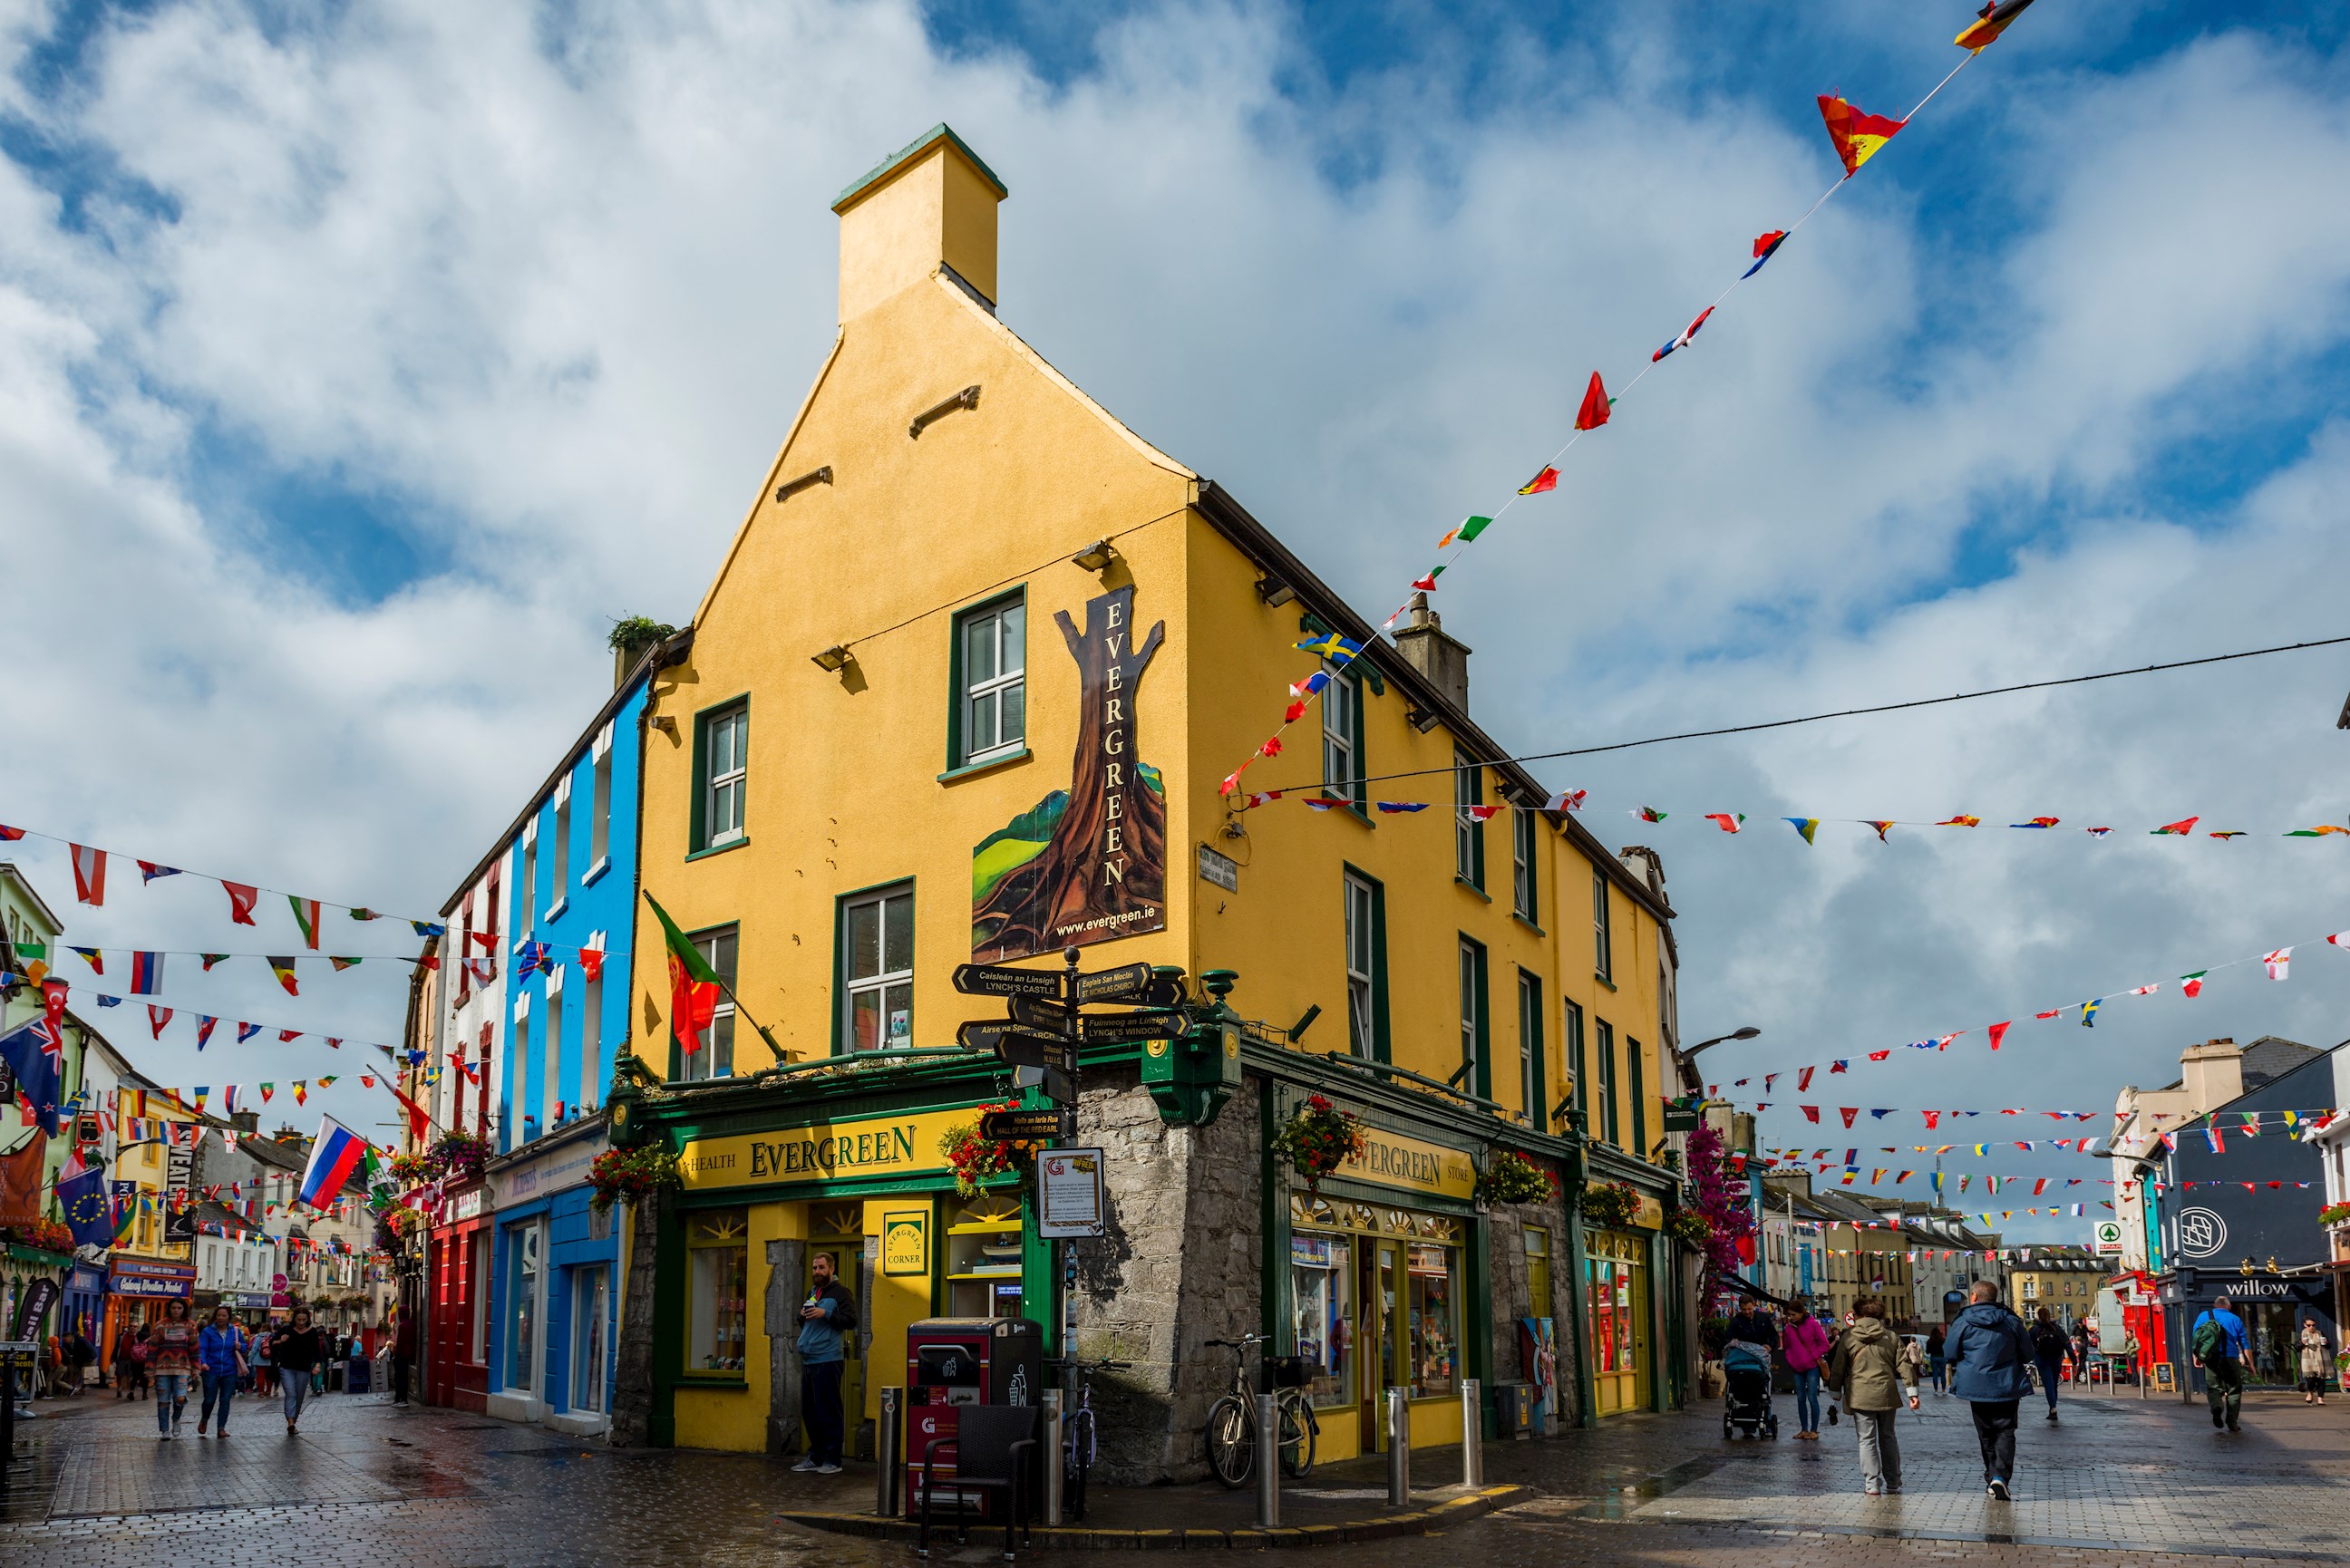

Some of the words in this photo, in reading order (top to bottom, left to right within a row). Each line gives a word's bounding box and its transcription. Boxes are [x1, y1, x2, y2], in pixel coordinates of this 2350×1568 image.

[1104, 602, 1124, 886] EVERGREEN
[1056, 905, 1155, 936] www.evergreen.ie
[1026, 973, 1055, 985] Linsigh
[1102, 975, 1113, 984] San
[986, 982, 1021, 992] LYNCH'S
[1023, 984, 1055, 995] CASTLE
[1089, 985, 1114, 997] NICHOLAS
[1113, 981, 1135, 992] CHURCH
[1089, 1018, 1126, 1027] Fuinneog
[1139, 1016, 1169, 1025] Linsigh
[1089, 1028, 1123, 1037] LYNCH'S
[1125, 1026, 1162, 1035] WINDOW
[1047, 1115, 1059, 1123] Rua
[996, 1127, 1011, 1135] HALL
[1012, 1126, 1020, 1134] OF
[1020, 1126, 1030, 1134] THE
[1031, 1126, 1043, 1134] RED
[1043, 1125, 1059, 1133] EARL
[691, 1154, 736, 1172] HEALTH
[750, 1124, 918, 1177] EVERGREEN
[1447, 1166, 1469, 1182] STORE
[887, 1229, 921, 1252] EVERGREEN
[888, 1254, 920, 1264] CORNER
[2226, 1279, 2289, 1295] willow
[33, 1284, 50, 1313] Bar
